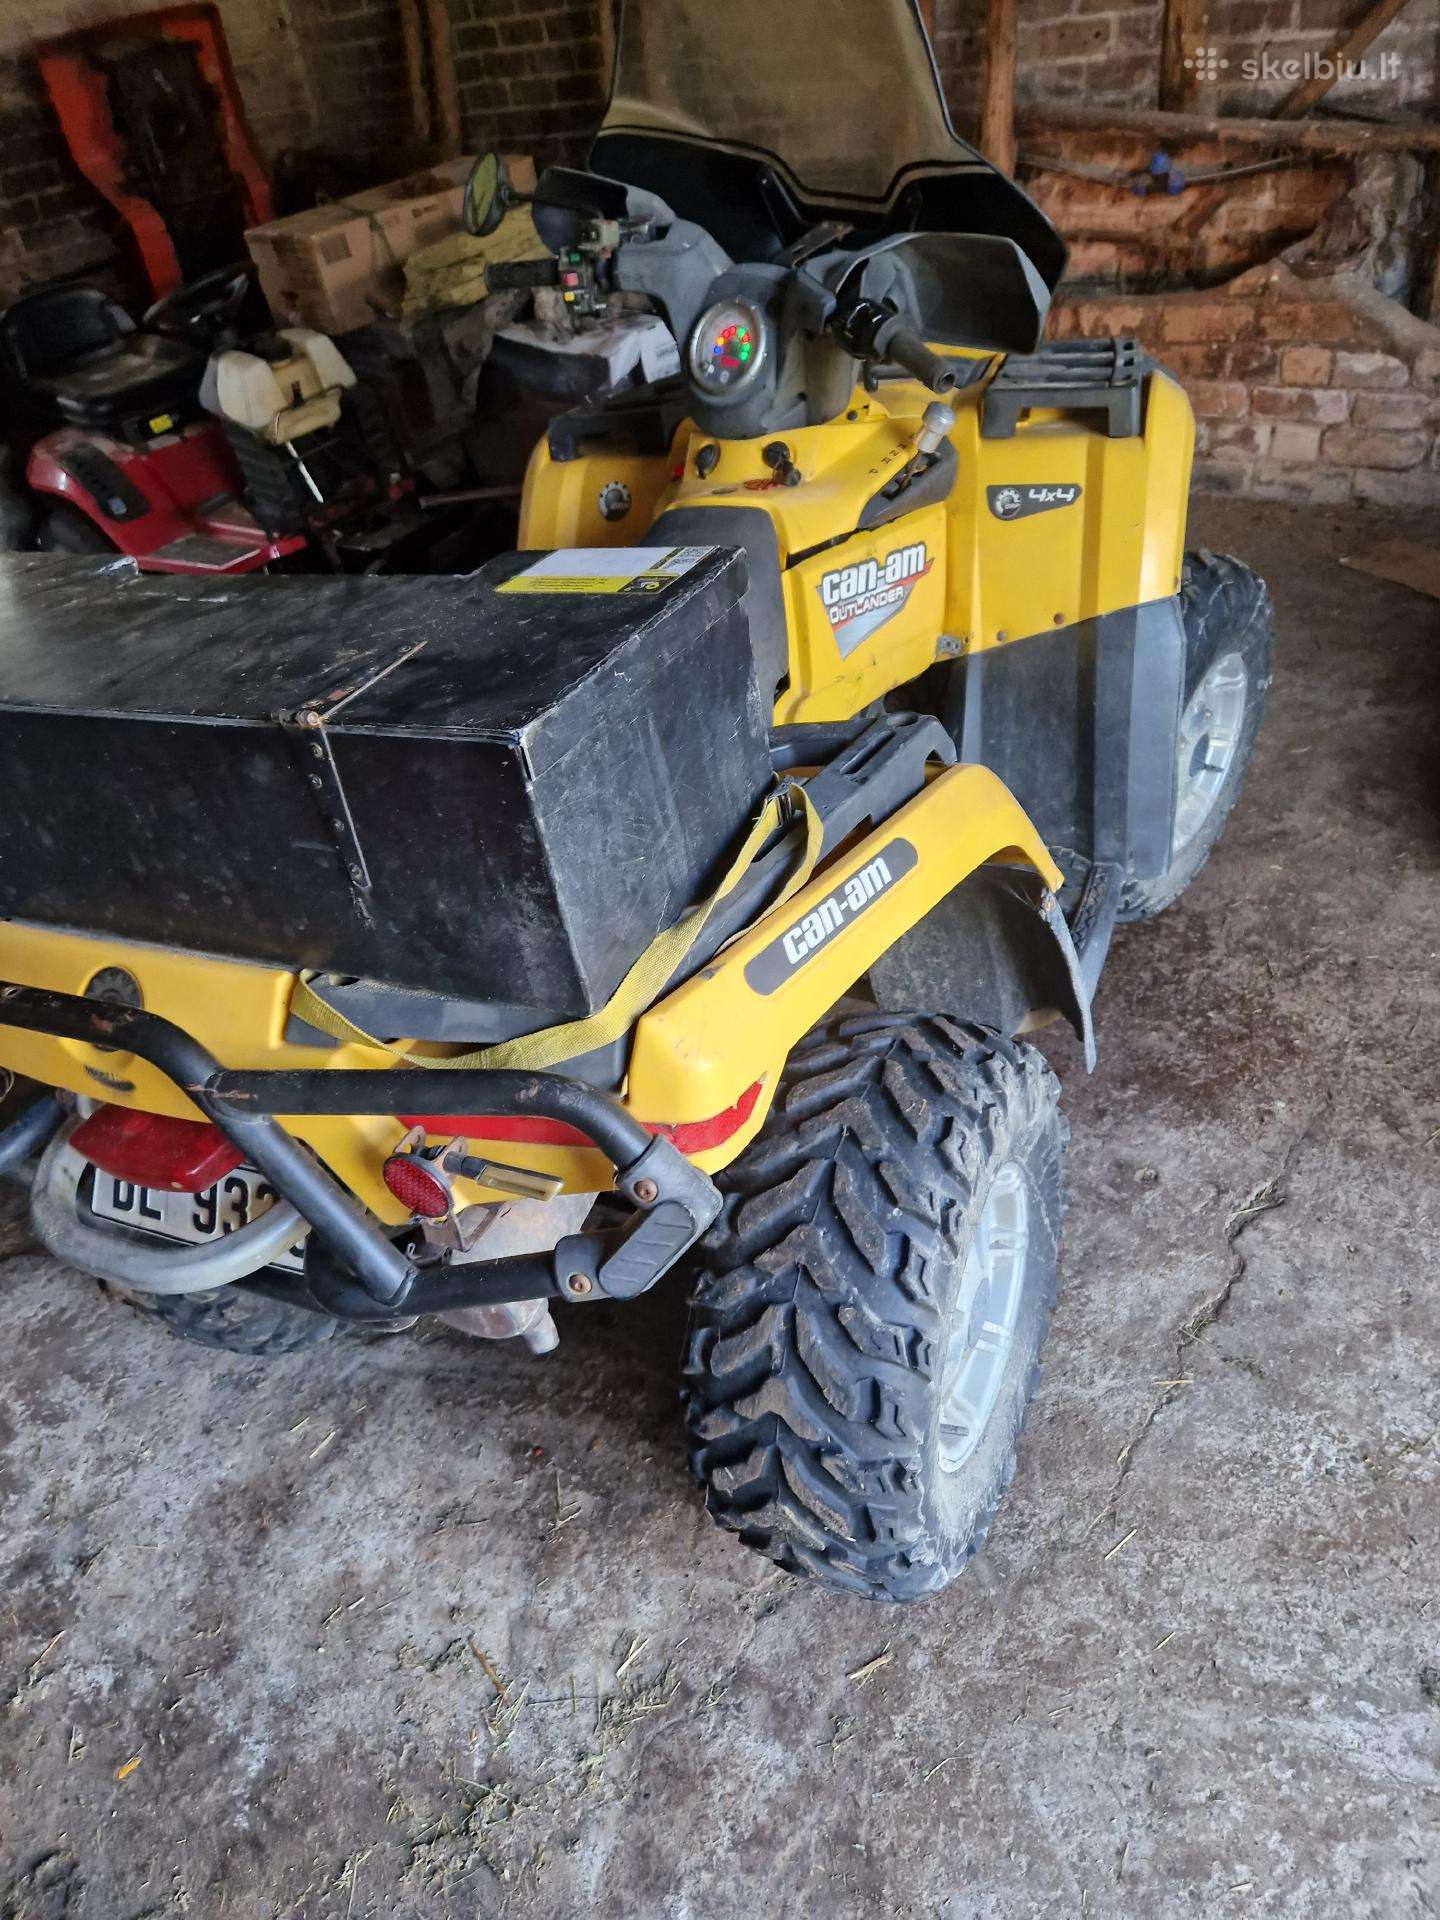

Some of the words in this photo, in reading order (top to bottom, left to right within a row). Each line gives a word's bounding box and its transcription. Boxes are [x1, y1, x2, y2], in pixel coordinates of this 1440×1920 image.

[1028, 488, 1075, 503] 4x4
[829, 585, 905, 625] OUTLANDER
[782, 857, 893, 965] can-am
